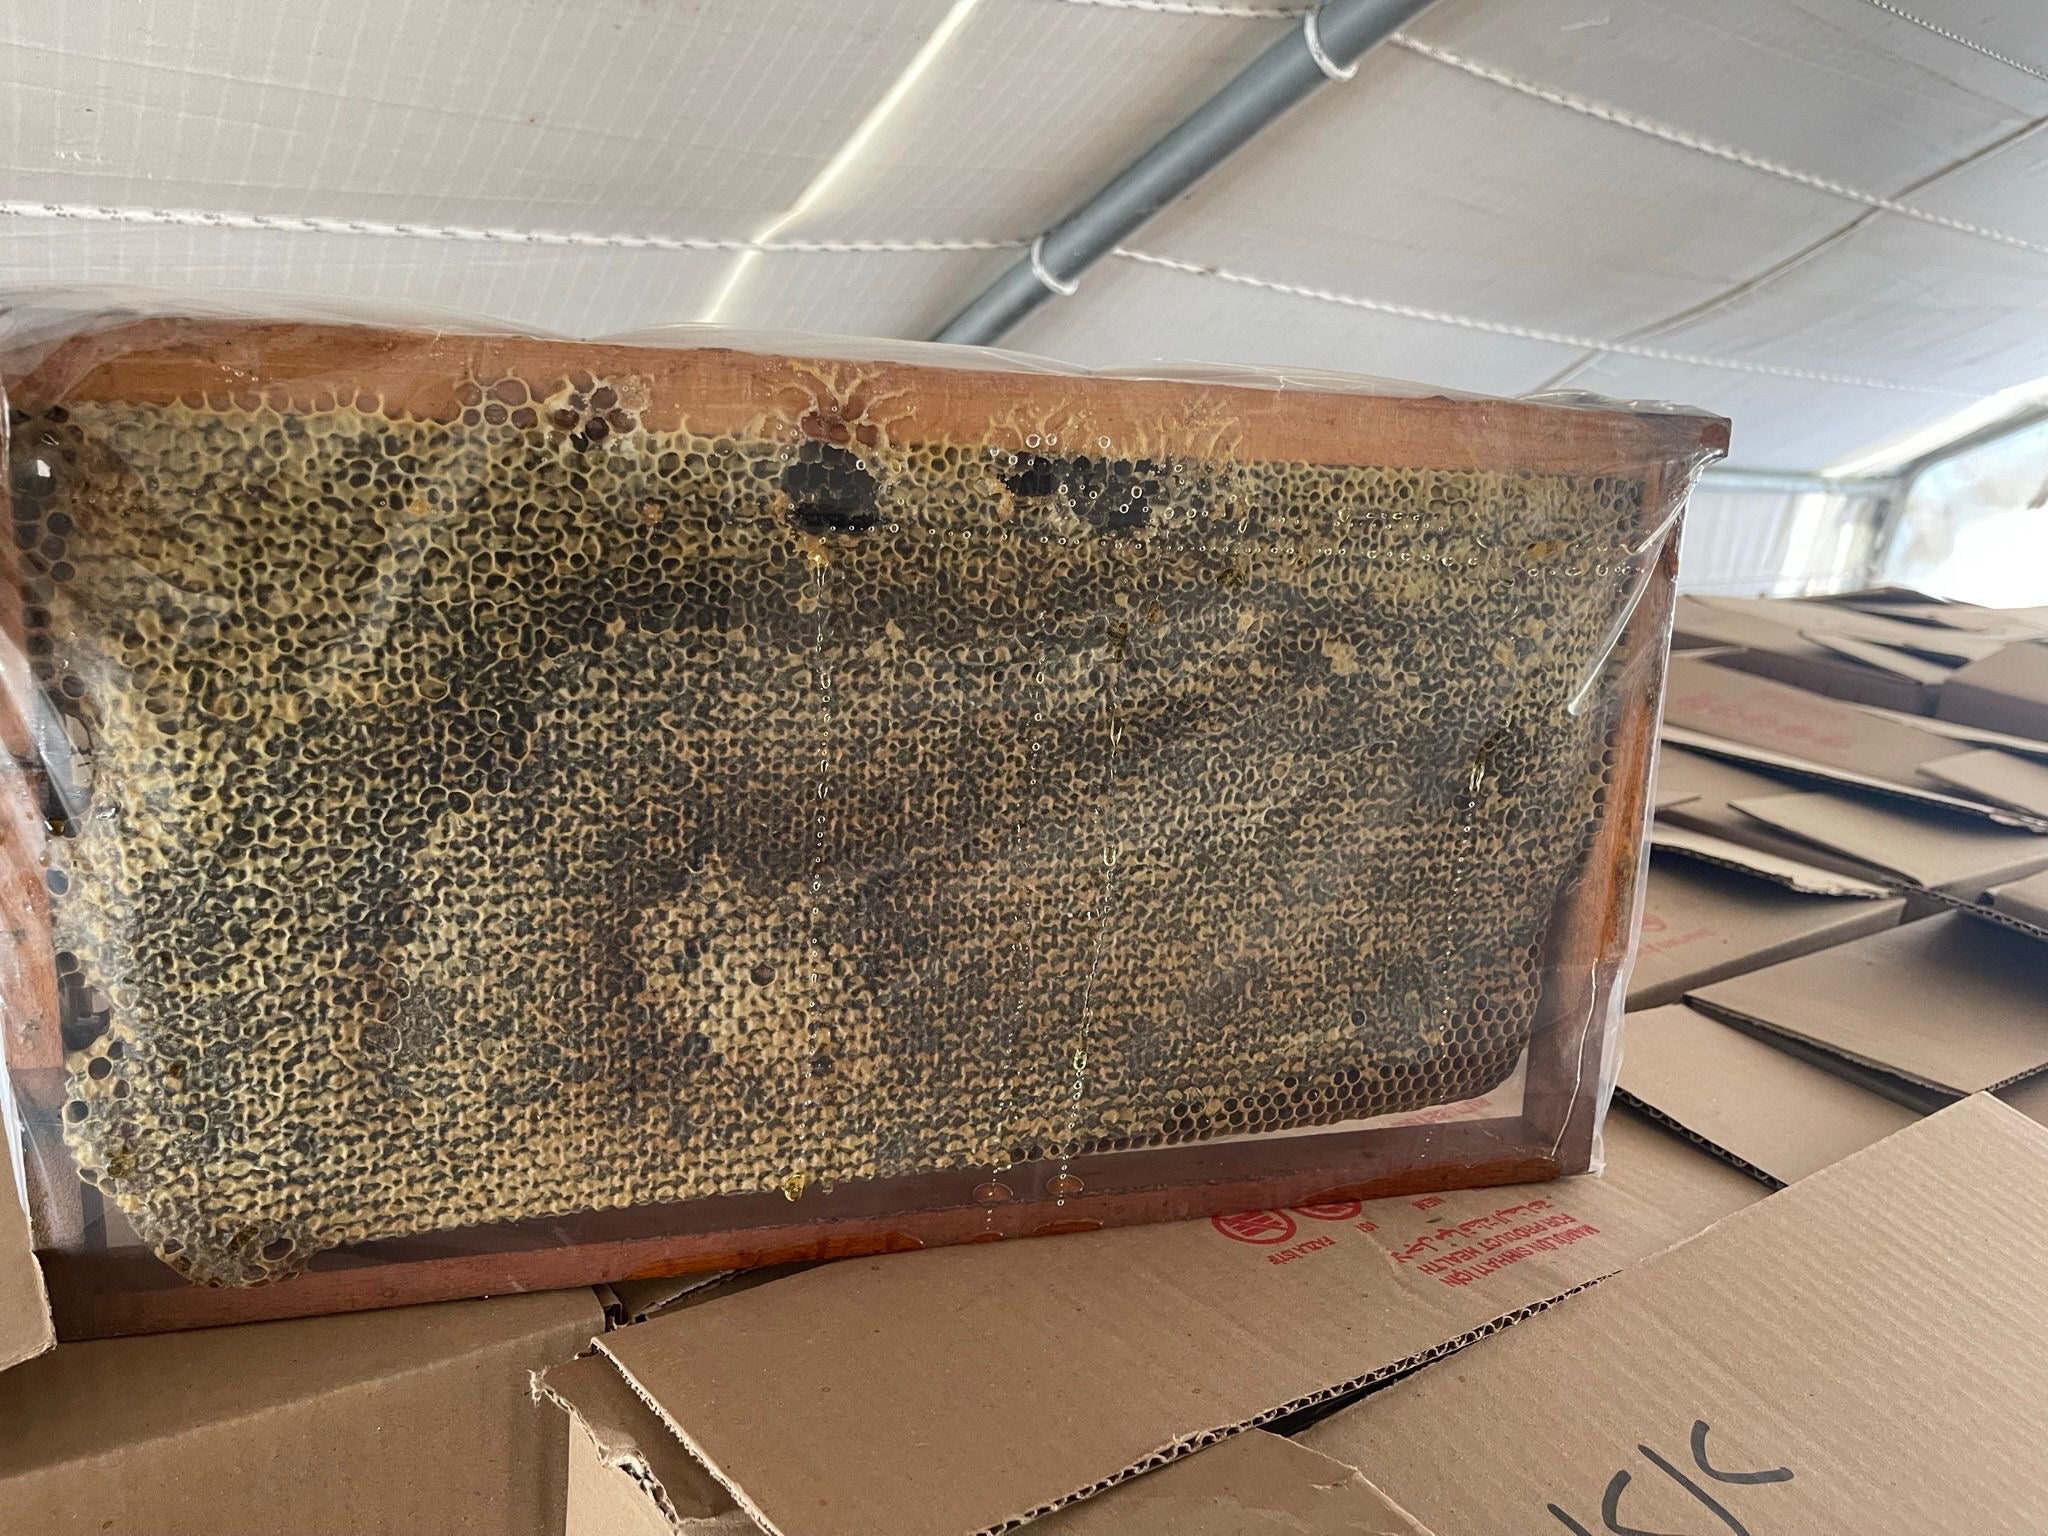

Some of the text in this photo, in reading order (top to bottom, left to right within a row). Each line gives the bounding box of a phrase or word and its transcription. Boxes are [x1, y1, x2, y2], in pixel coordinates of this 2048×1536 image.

[1299, 1235, 1337, 1255] FAZLA
[1417, 1212, 1578, 1276] FOR PRODUCT HEALTH
